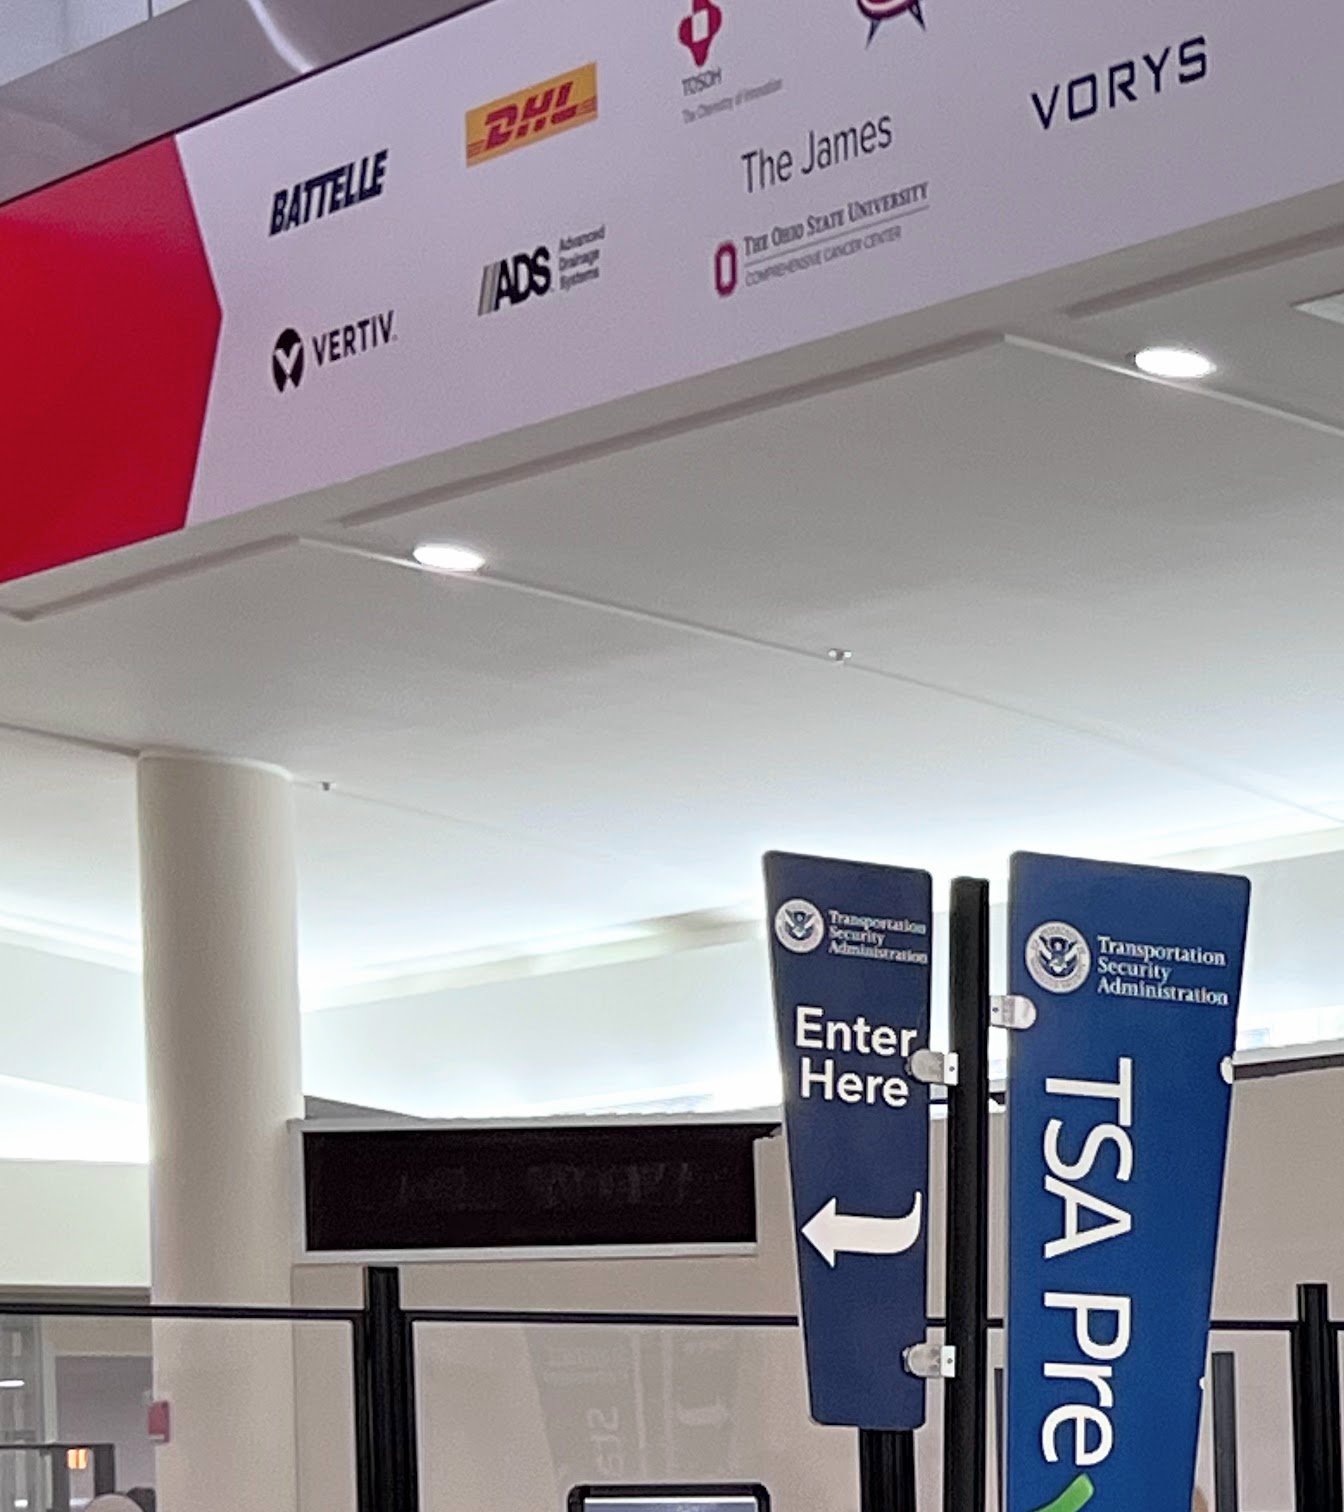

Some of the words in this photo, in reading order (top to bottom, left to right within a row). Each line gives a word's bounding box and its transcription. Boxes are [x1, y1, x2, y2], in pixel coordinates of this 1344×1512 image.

[1030, 35, 1206, 130] VORYS
[484, 81, 578, 150] DHL
[740, 148, 793, 193] The
[801, 115, 893, 174] James
[269, 148, 388, 237] BATTELLE
[493, 245, 551, 312] ADS
[312, 309, 395, 367] VERTIV
[828, 909, 927, 935] Transportation
[828, 925, 886, 945] Security
[828, 941, 929, 965] Administration
[1097, 935, 1227, 966] Transportation
[1097, 956, 1172, 983] Security
[1097, 977, 1229, 1006] Administration
[795, 1005, 918, 1058] Enter
[801, 1056, 909, 1108] Here
[1043, 1057, 1134, 1259] TSA
[1041, 1291, 1133, 1467] Pre
